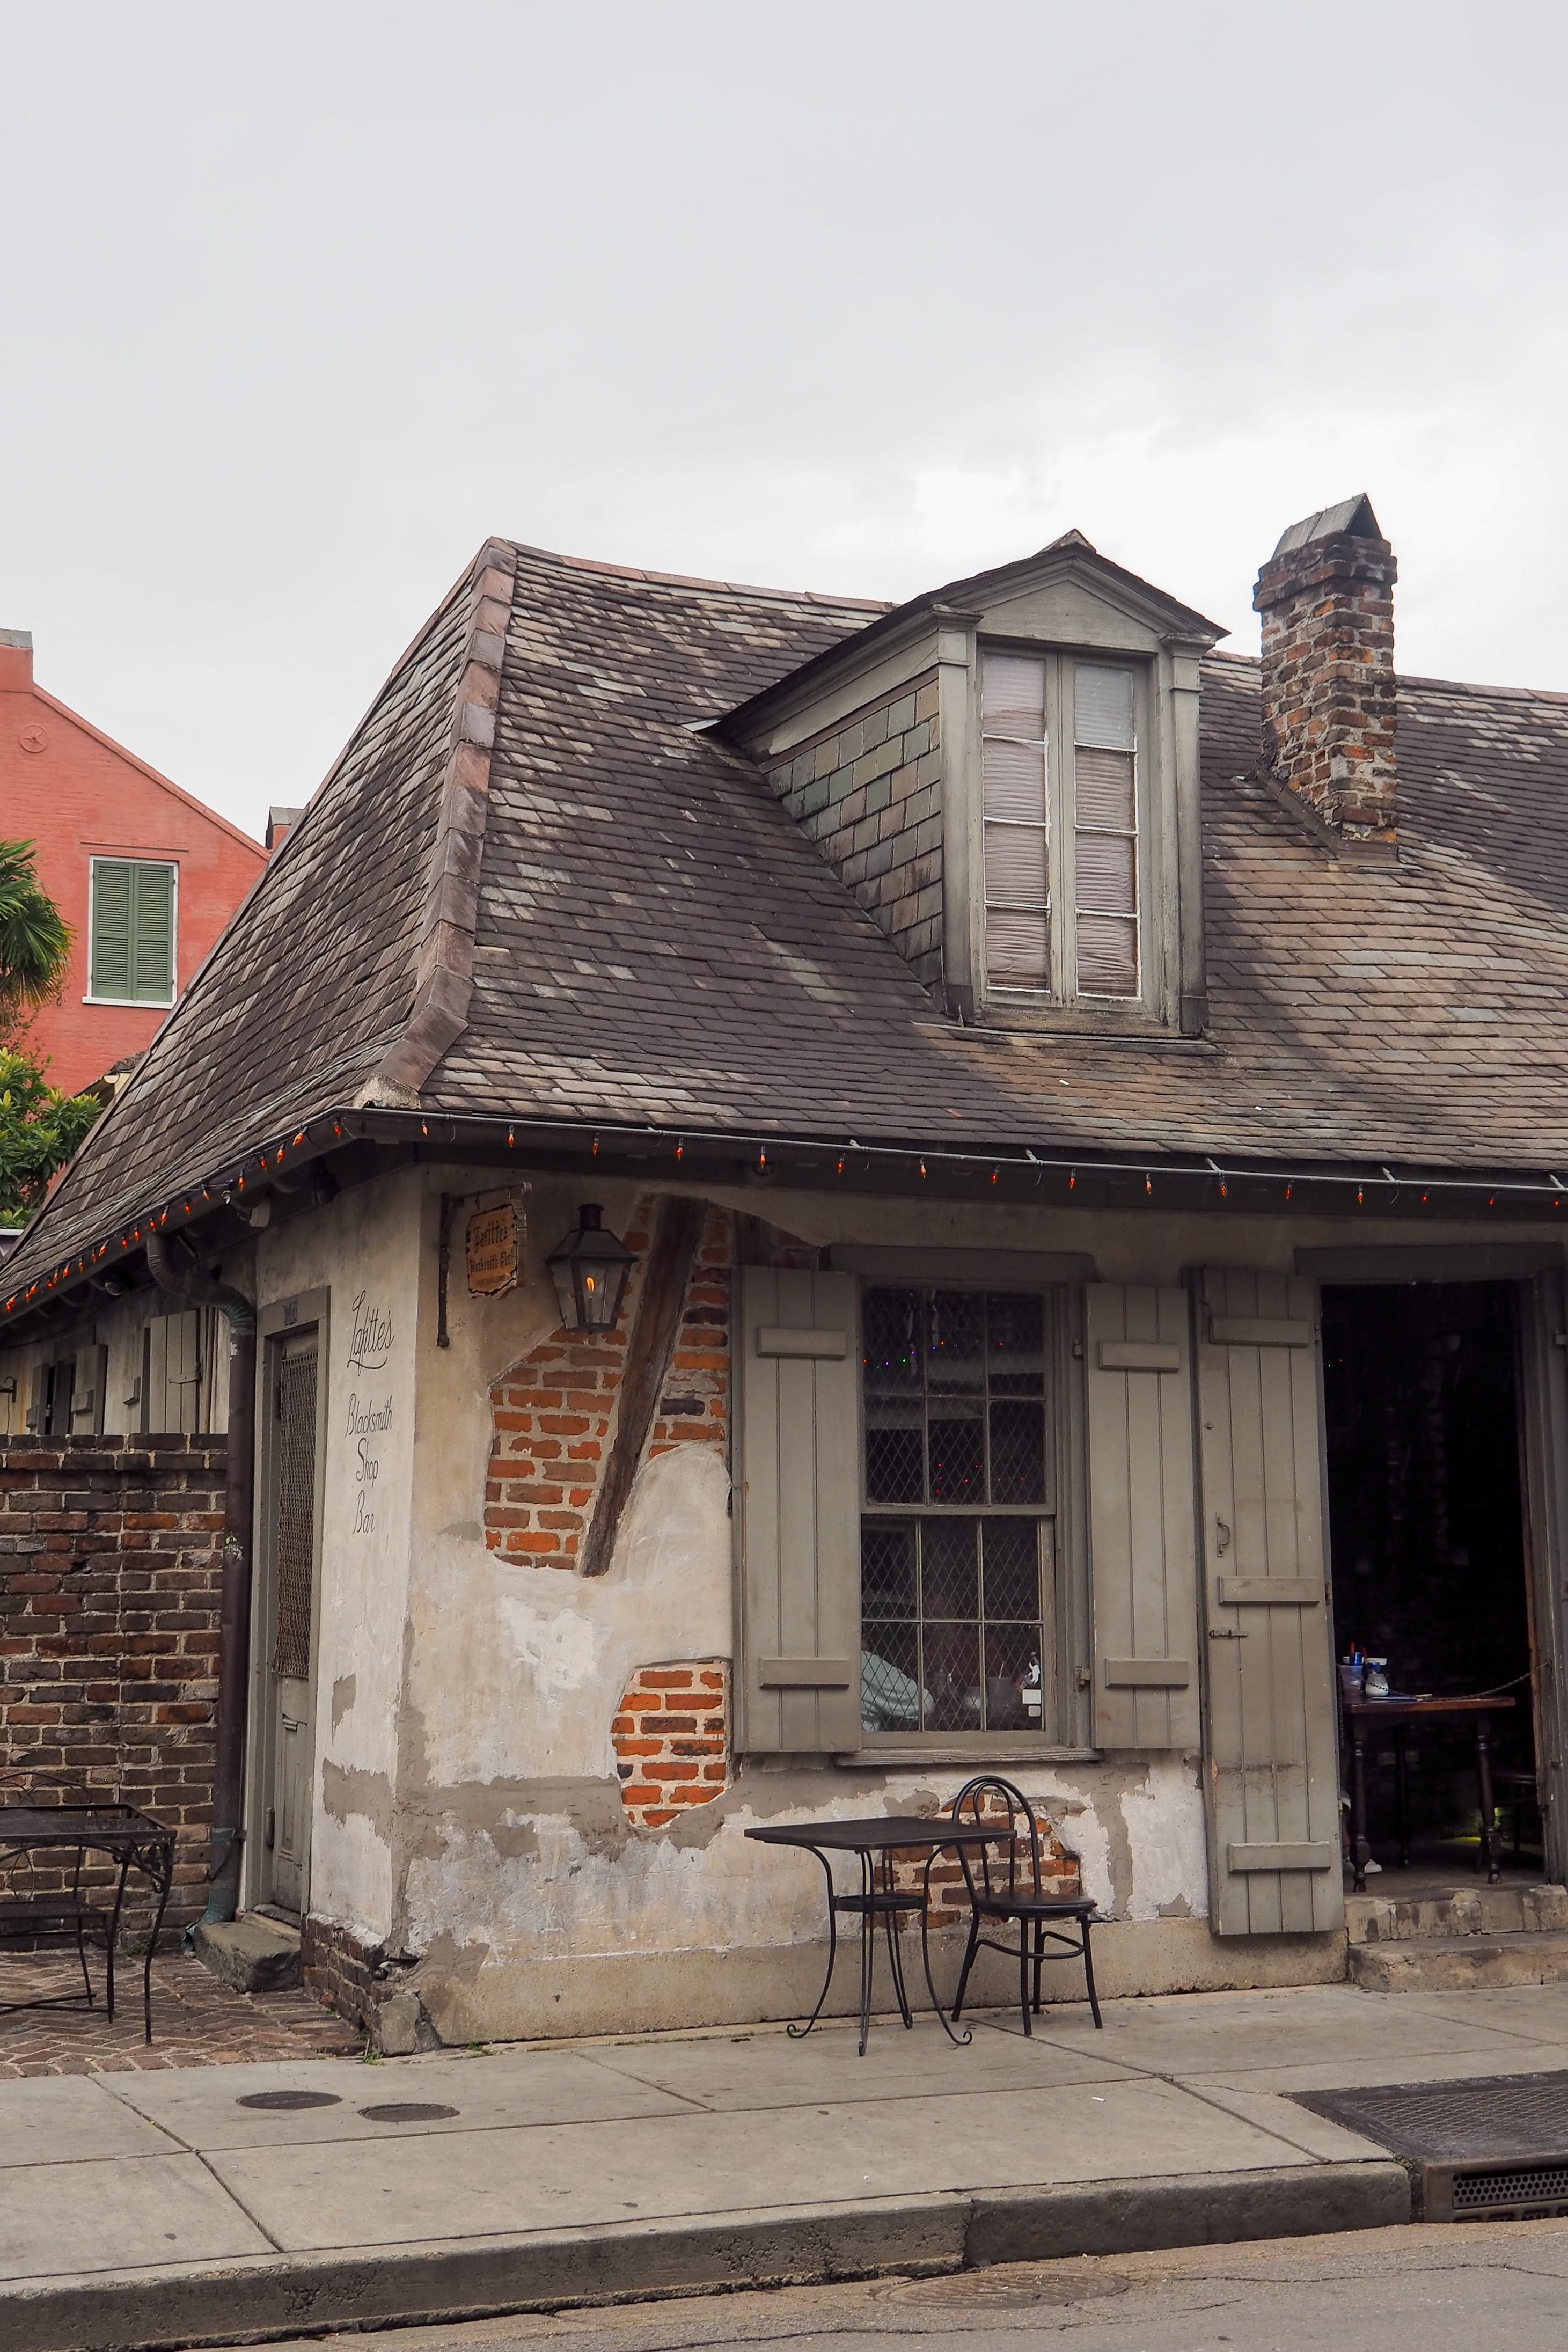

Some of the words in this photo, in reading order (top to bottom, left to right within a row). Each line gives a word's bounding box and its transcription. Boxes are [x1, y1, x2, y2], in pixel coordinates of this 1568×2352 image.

[347, 1289, 395, 1377] Lafitte's
[345, 1393, 393, 1438] Blacksmith
[356, 1437, 378, 1488] Shop
[352, 1489, 376, 1534] Bar
